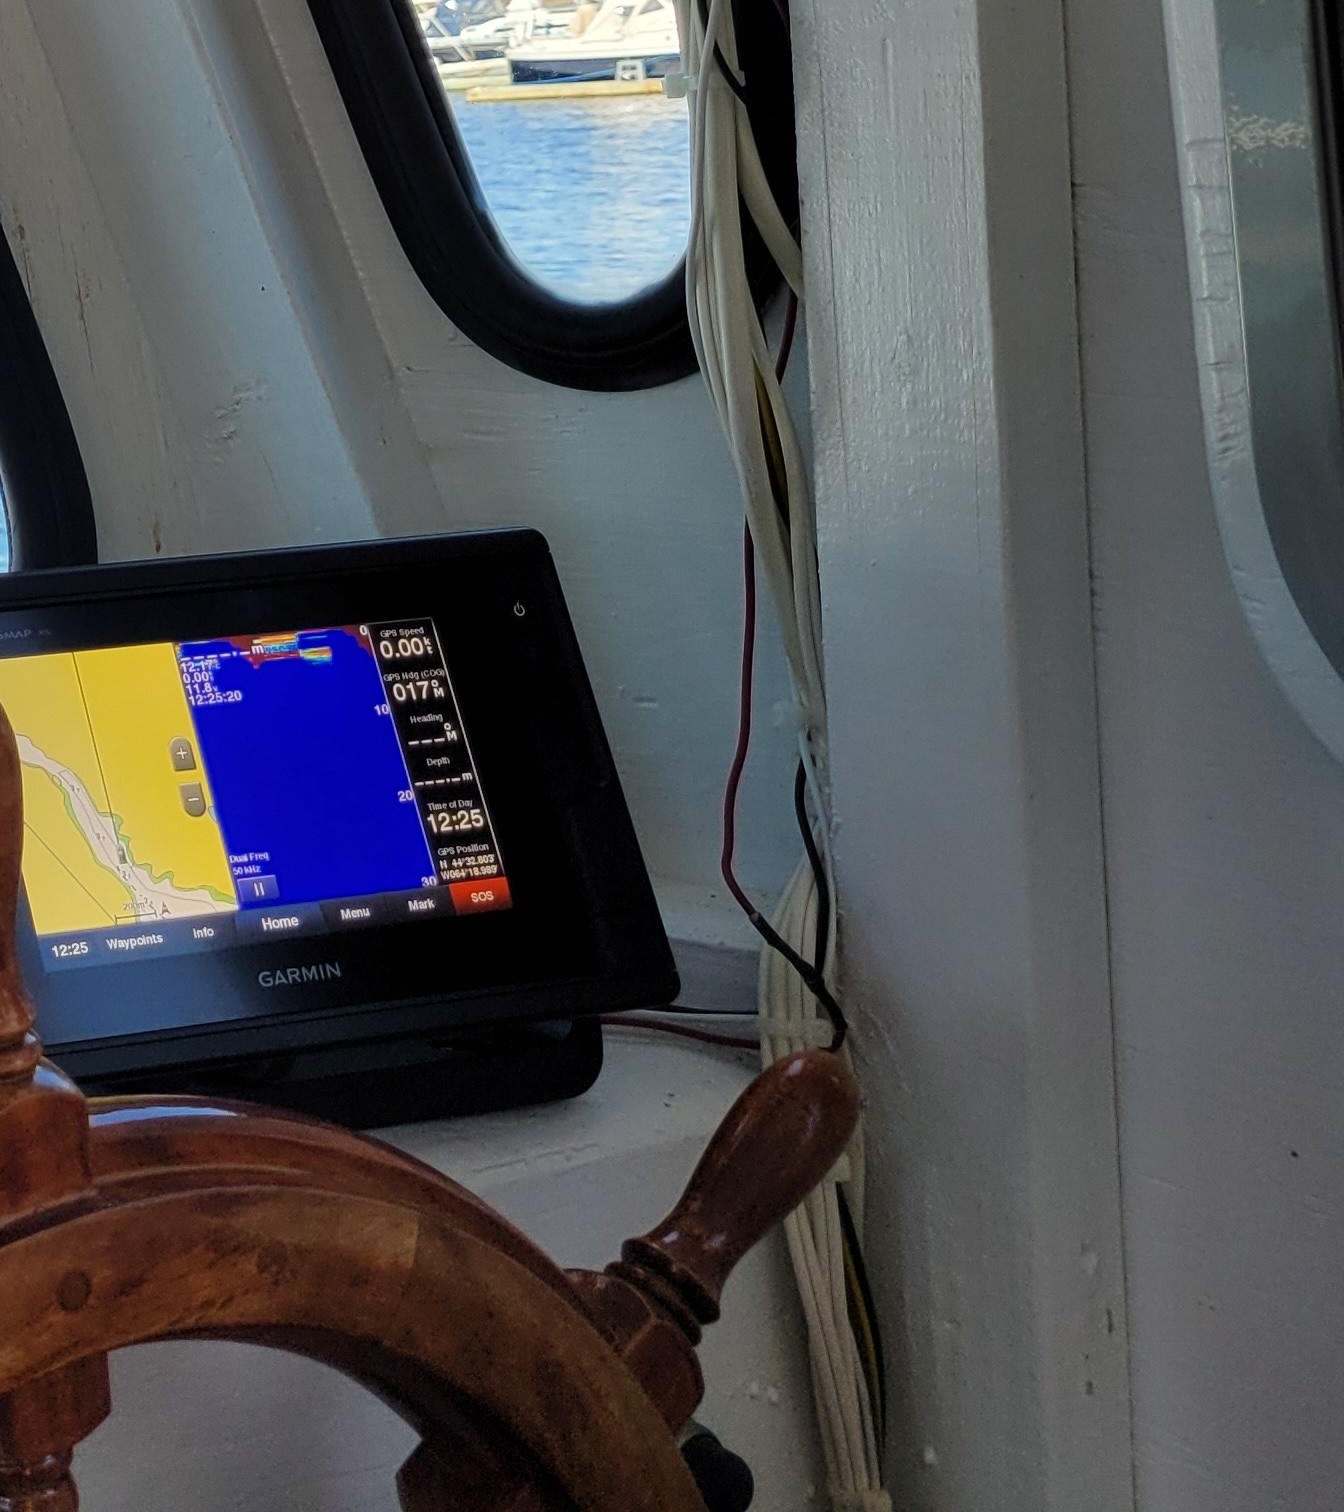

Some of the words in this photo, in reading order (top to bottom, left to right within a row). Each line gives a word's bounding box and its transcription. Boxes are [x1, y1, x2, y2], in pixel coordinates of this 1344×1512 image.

[359, 624, 368, 636] 0
[380, 629, 397, 638] GPS
[399, 626, 425, 637] Speed
[379, 637, 424, 659] 0.00
[383, 671, 401, 682] GPS
[393, 680, 430, 701] 017
[188, 690, 243, 706] 12:25:20
[374, 703, 390, 716] 10
[409, 713, 444, 724] Heading
[426, 756, 451, 768] Depth
[397, 790, 413, 802] 20
[427, 801, 448, 811] Time
[457, 799, 474, 808] Day
[426, 808, 485, 835] 12:25
[437, 846, 455, 857] GPS
[456, 843, 490, 855] Position
[229, 854, 249, 863] Dual
[249, 852, 270, 862] Freq
[421, 876, 437, 887] 30
[51, 941, 89, 958] 12:25
[106, 933, 164, 951] Waypoints
[193, 927, 215, 940] Info
[261, 914, 300, 931] Home
[340, 907, 371, 921] Menu
[408, 898, 436, 912] Mark
[470, 890, 495, 903] SOS
[258, 962, 342, 988] GARMIN
